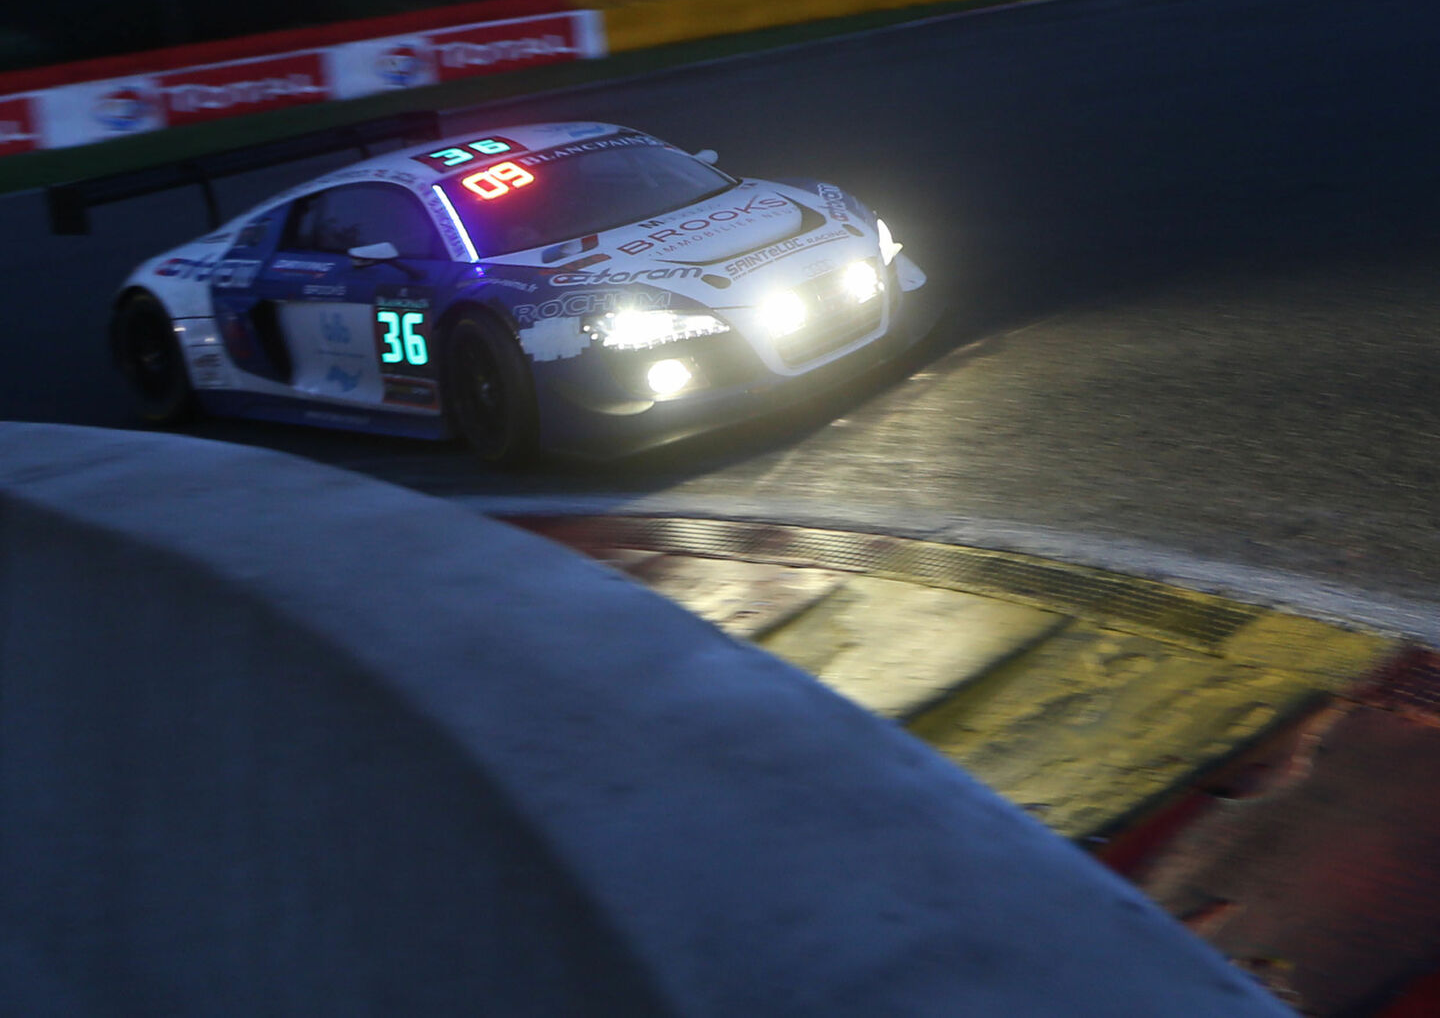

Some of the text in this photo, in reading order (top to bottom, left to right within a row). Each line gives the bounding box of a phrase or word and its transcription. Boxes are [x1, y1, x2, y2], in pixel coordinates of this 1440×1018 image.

[429, 139, 511, 167] 36
[519, 135, 650, 167] BLANCPAIN
[461, 161, 535, 201] 09
[616, 194, 788, 256] BROOKS
[806, 229, 848, 245] RACING
[376, 310, 430, 366] 36
